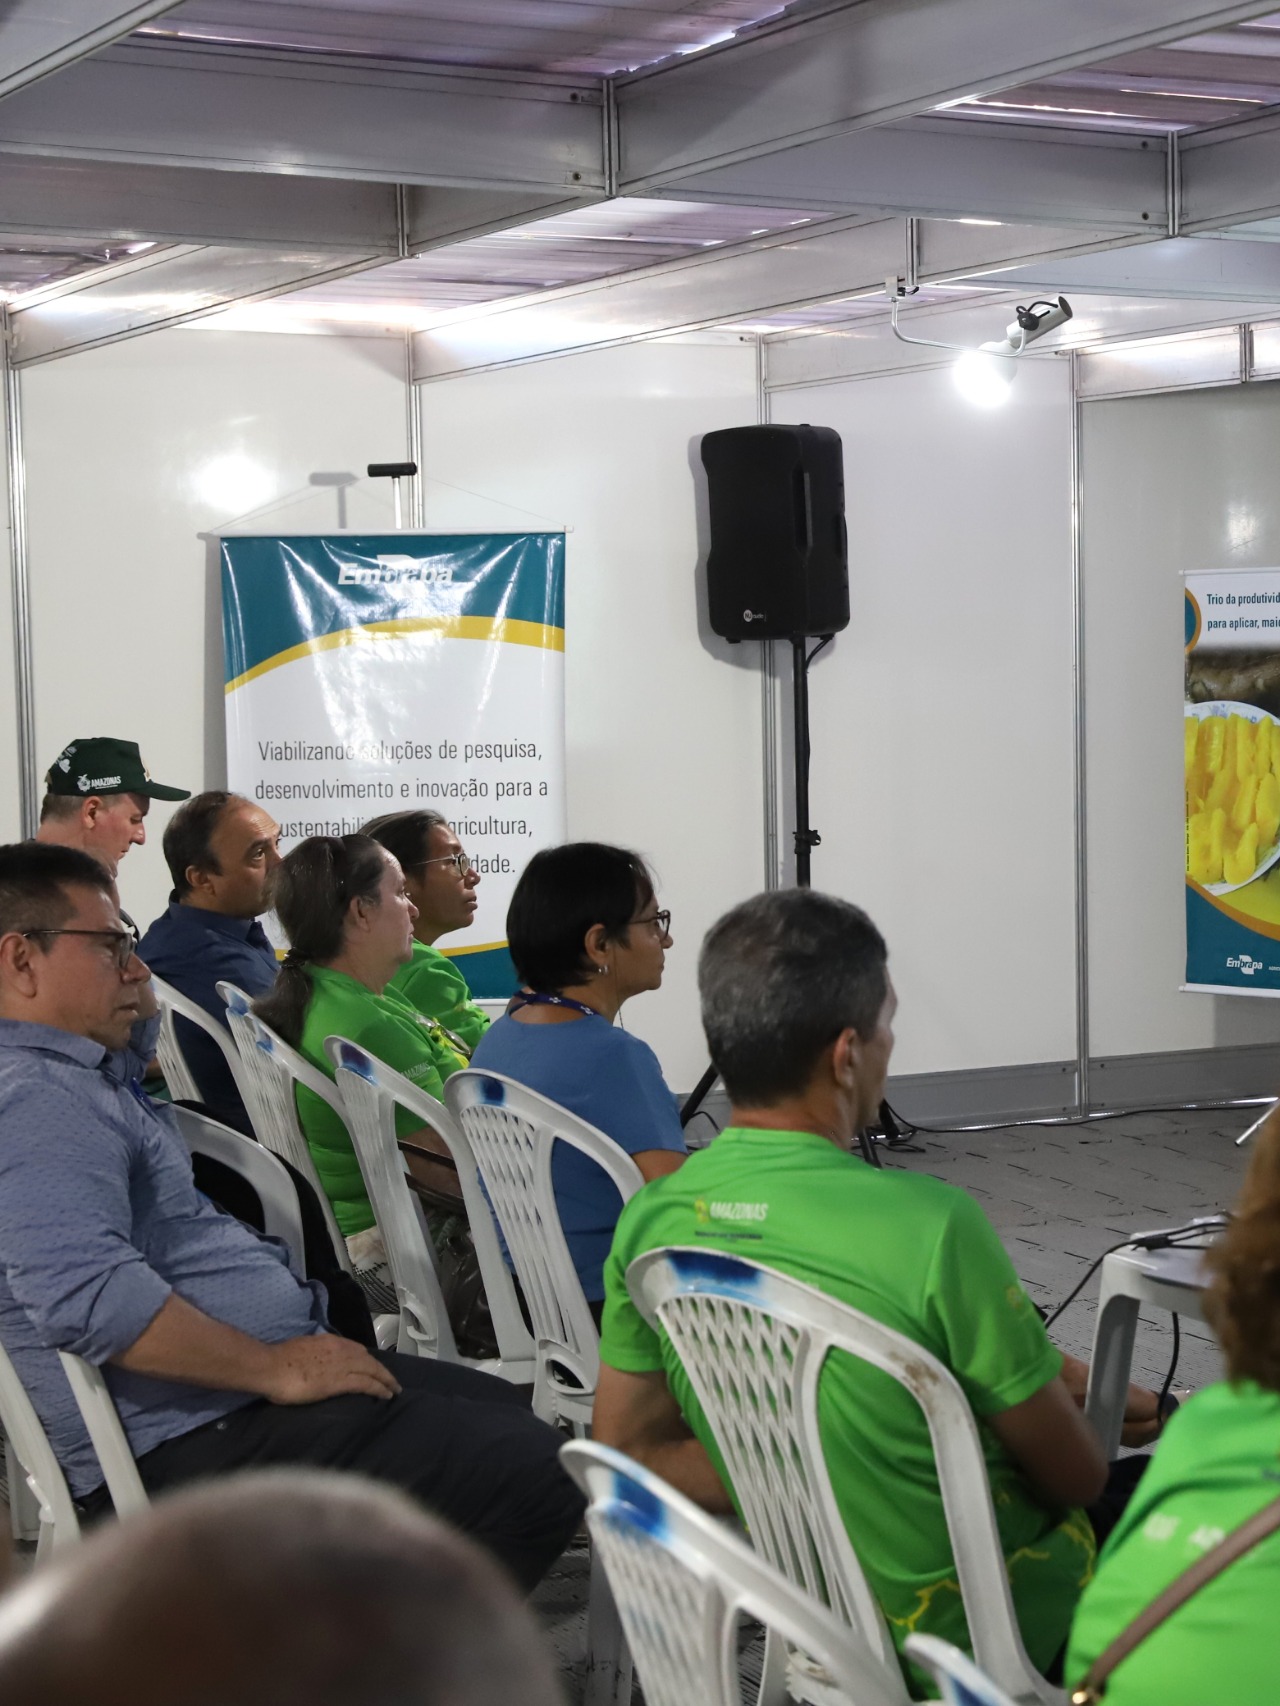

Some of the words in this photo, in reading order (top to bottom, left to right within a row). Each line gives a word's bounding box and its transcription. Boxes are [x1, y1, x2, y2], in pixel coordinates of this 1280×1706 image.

[1207, 593, 1224, 605] Trio
[1226, 593, 1236, 605] da
[1208, 619, 1227, 631] para
[1229, 616, 1260, 631] aplicar,
[258, 740, 355, 761] Viabilizando
[361, 739, 432, 764] soluções
[438, 739, 458, 760] de
[464, 738, 542, 763] pesquisa,
[255, 779, 394, 800] desenvolvimento
[400, 782, 410, 798] e
[416, 778, 489, 802] inovação
[496, 780, 533, 801] para
[539, 780, 549, 797] a
[448, 816, 533, 838] gricultura,
[1226, 957, 1263, 971] Embrapa
